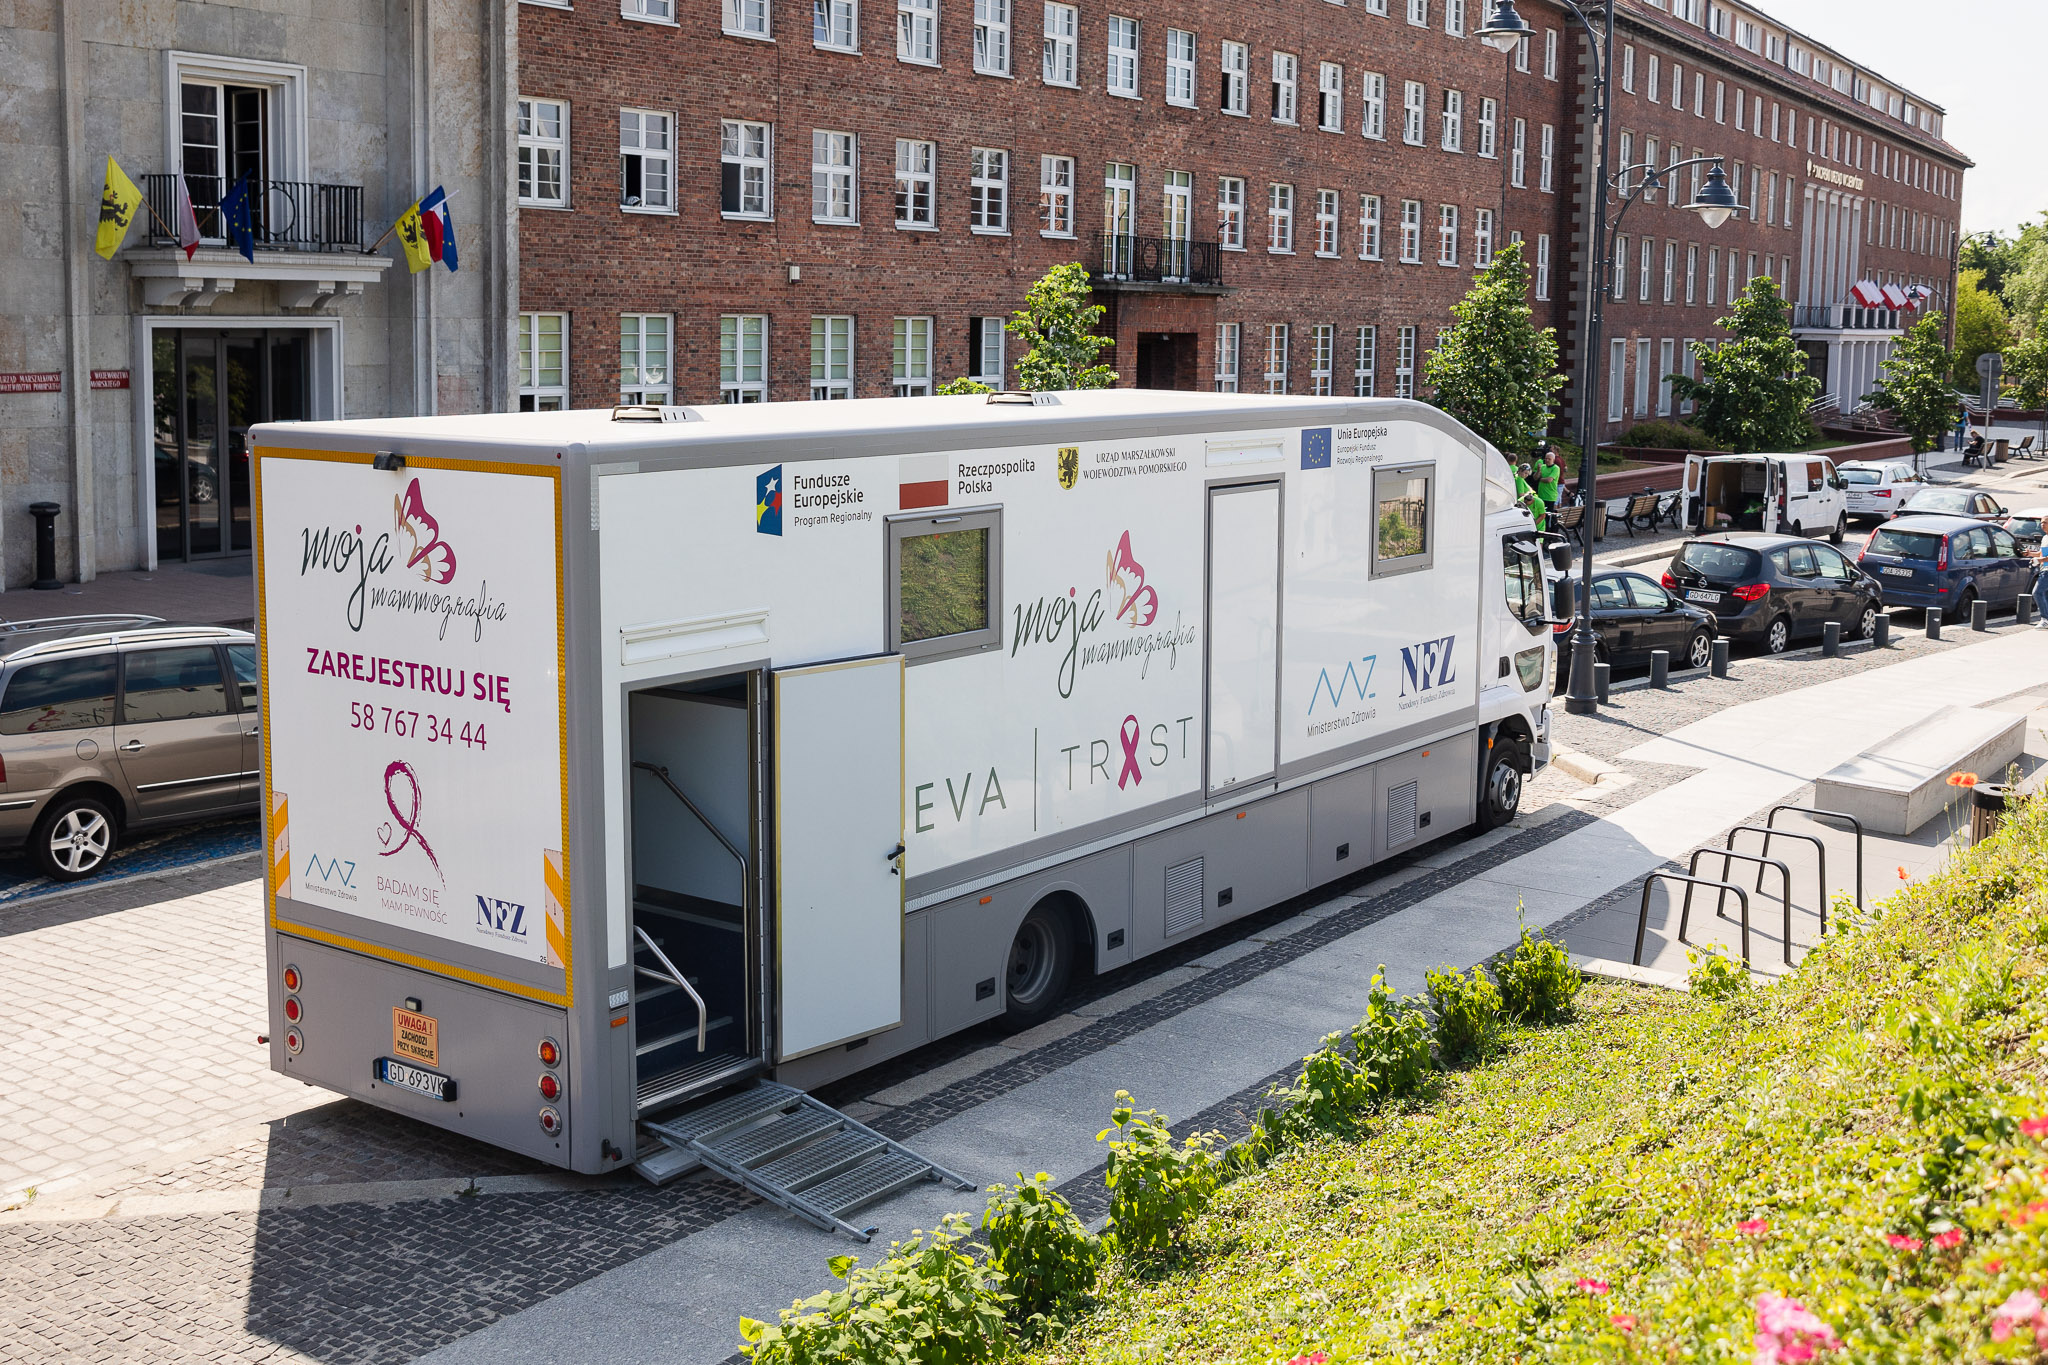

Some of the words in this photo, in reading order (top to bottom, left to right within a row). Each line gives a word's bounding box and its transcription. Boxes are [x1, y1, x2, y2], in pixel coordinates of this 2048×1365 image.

[1337, 428, 1352, 440] Unia
[1353, 425, 1388, 440] Europejska
[1096, 451, 1119, 463] URZĄD
[1121, 447, 1176, 461] MARSZAŁKOWSKI
[958, 458, 1036, 478] Rzeczpospolita
[1083, 465, 1137, 480] WOJEWÓDZTWA
[1138, 461, 1187, 475] POMORSKIEGO
[794, 473, 850, 491] Fundusze
[958, 479, 993, 495] Polska
[794, 489, 864, 510] Europejskie
[794, 514, 829, 527] Program
[830, 510, 873, 525] Regionalny
[302, 524, 394, 632] moja
[1690, 591, 1699, 599] GD
[1700, 593, 1719, 602] 647LG
[371, 580, 507, 642] mammografia
[1011, 587, 1105, 699] moja
[1082, 611, 1195, 680] mammografia
[1399, 635, 1456, 698] NFZ
[307, 647, 466, 698] ZAREJESTRUJ
[473, 672, 511, 713] SIĘ
[351, 701, 375, 731] 58
[381, 706, 419, 738] 767
[427, 715, 453, 745] 34
[460, 721, 487, 750] 44
[1307, 716, 1350, 737] Ministerstwo
[1351, 706, 1376, 725] Zdrowia
[915, 766, 1007, 834] EVA
[305, 882, 338, 897] Ministerstwo
[338, 889, 358, 902] Zdrowia
[377, 875, 421, 900] BADAM
[422, 887, 440, 909] SIĘ
[381, 898, 403, 913] MAM
[404, 905, 448, 925] PEWNOŚĆ
[475, 894, 528, 937] NFZ
[398, 1013, 427, 1032] UWAGA
[397, 1039, 410, 1052] PRZY
[410, 1045, 434, 1059] SKRĘCIE
[401, 1029, 428, 1046] ZACHODZI
[390, 1063, 405, 1083] GD
[408, 1069, 444, 1095] 693VK
